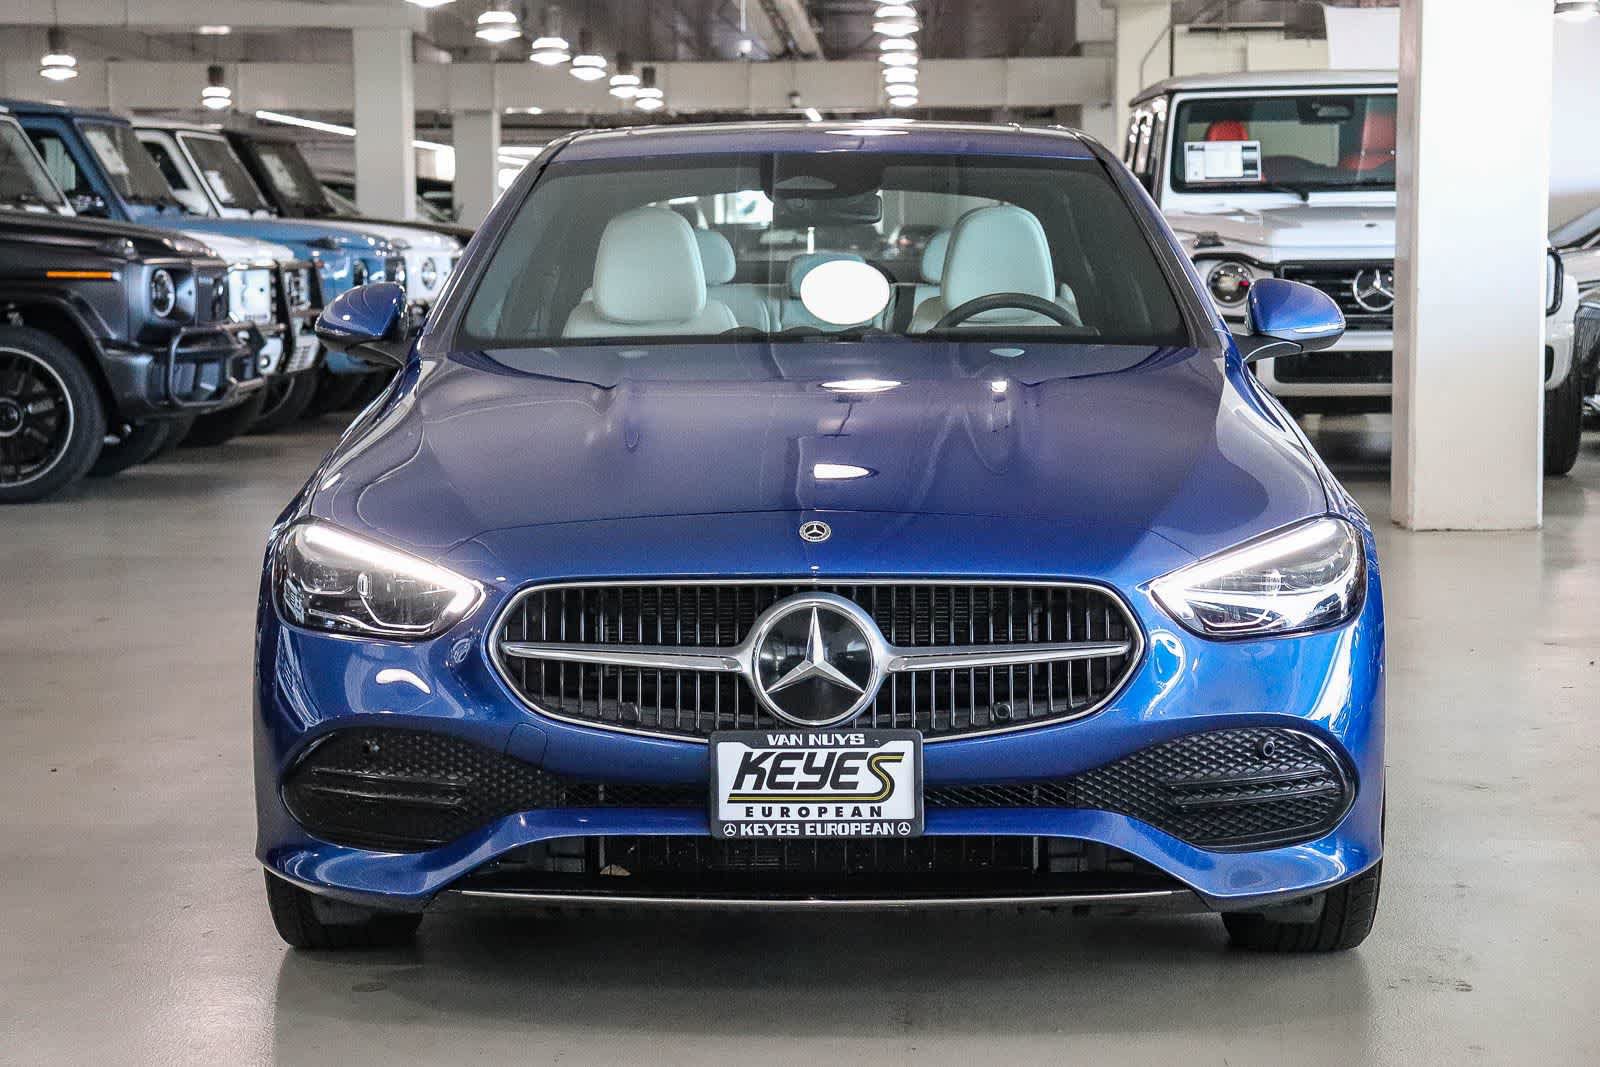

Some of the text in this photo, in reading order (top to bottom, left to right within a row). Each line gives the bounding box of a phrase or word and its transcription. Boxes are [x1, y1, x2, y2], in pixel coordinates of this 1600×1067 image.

[767, 733, 865, 746] VAN NUYS
[728, 751, 905, 803] KEYES
[745, 805, 883, 818] EUROPEAN
[740, 822, 895, 836] KEYES EUROPEAN
